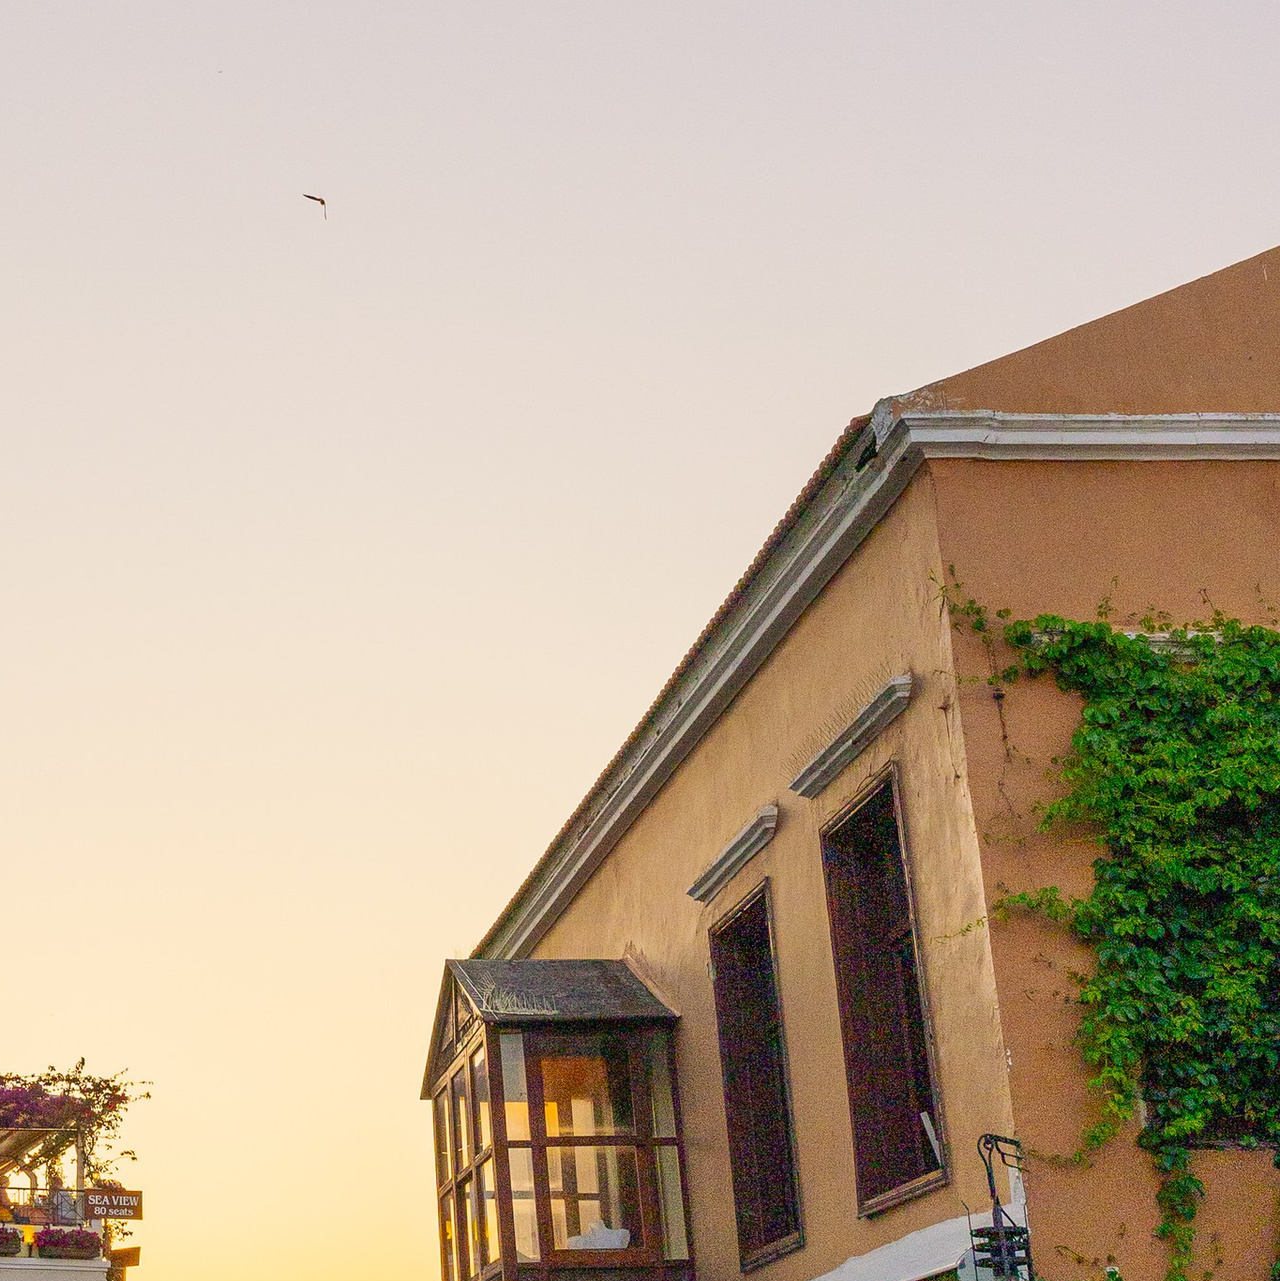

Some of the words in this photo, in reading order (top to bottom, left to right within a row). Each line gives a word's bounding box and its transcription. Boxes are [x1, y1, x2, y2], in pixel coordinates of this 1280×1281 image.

[88, 1195, 110, 1205] SEA
[112, 1195, 139, 1206] VIEW
[94, 1206, 107, 1215] 80
[108, 1208, 134, 1216] seats
